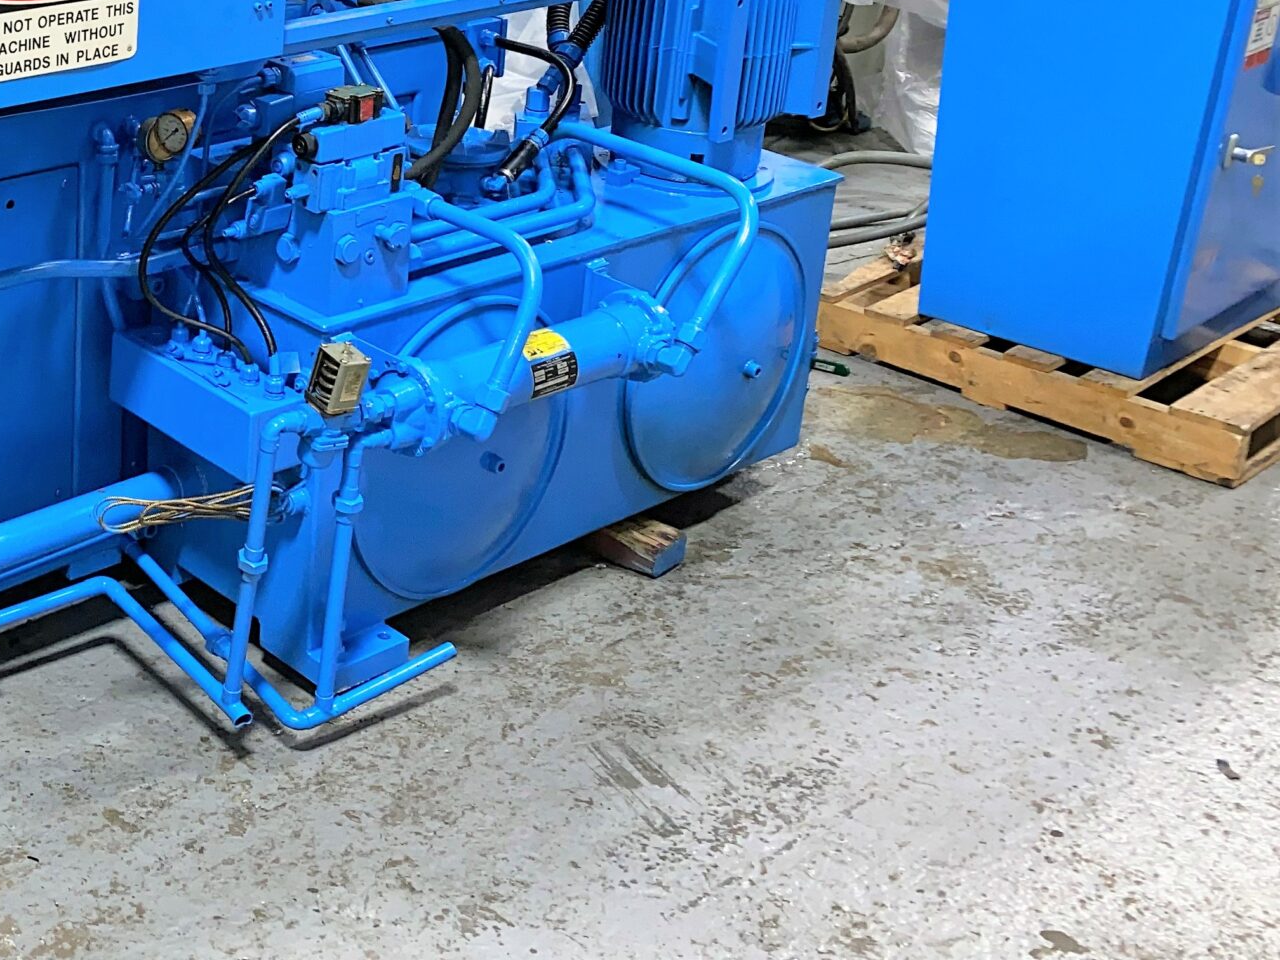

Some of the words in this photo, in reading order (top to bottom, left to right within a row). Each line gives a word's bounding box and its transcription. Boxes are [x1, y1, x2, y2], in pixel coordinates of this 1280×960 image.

[3, 18, 32, 35] NOT
[38, 7, 99, 29] OPERATE
[106, 2, 134, 18] THIS
[64, 23, 125, 44] WITHOUT
[56, 53, 69, 66] IN
[76, 44, 119, 63] PLACE
